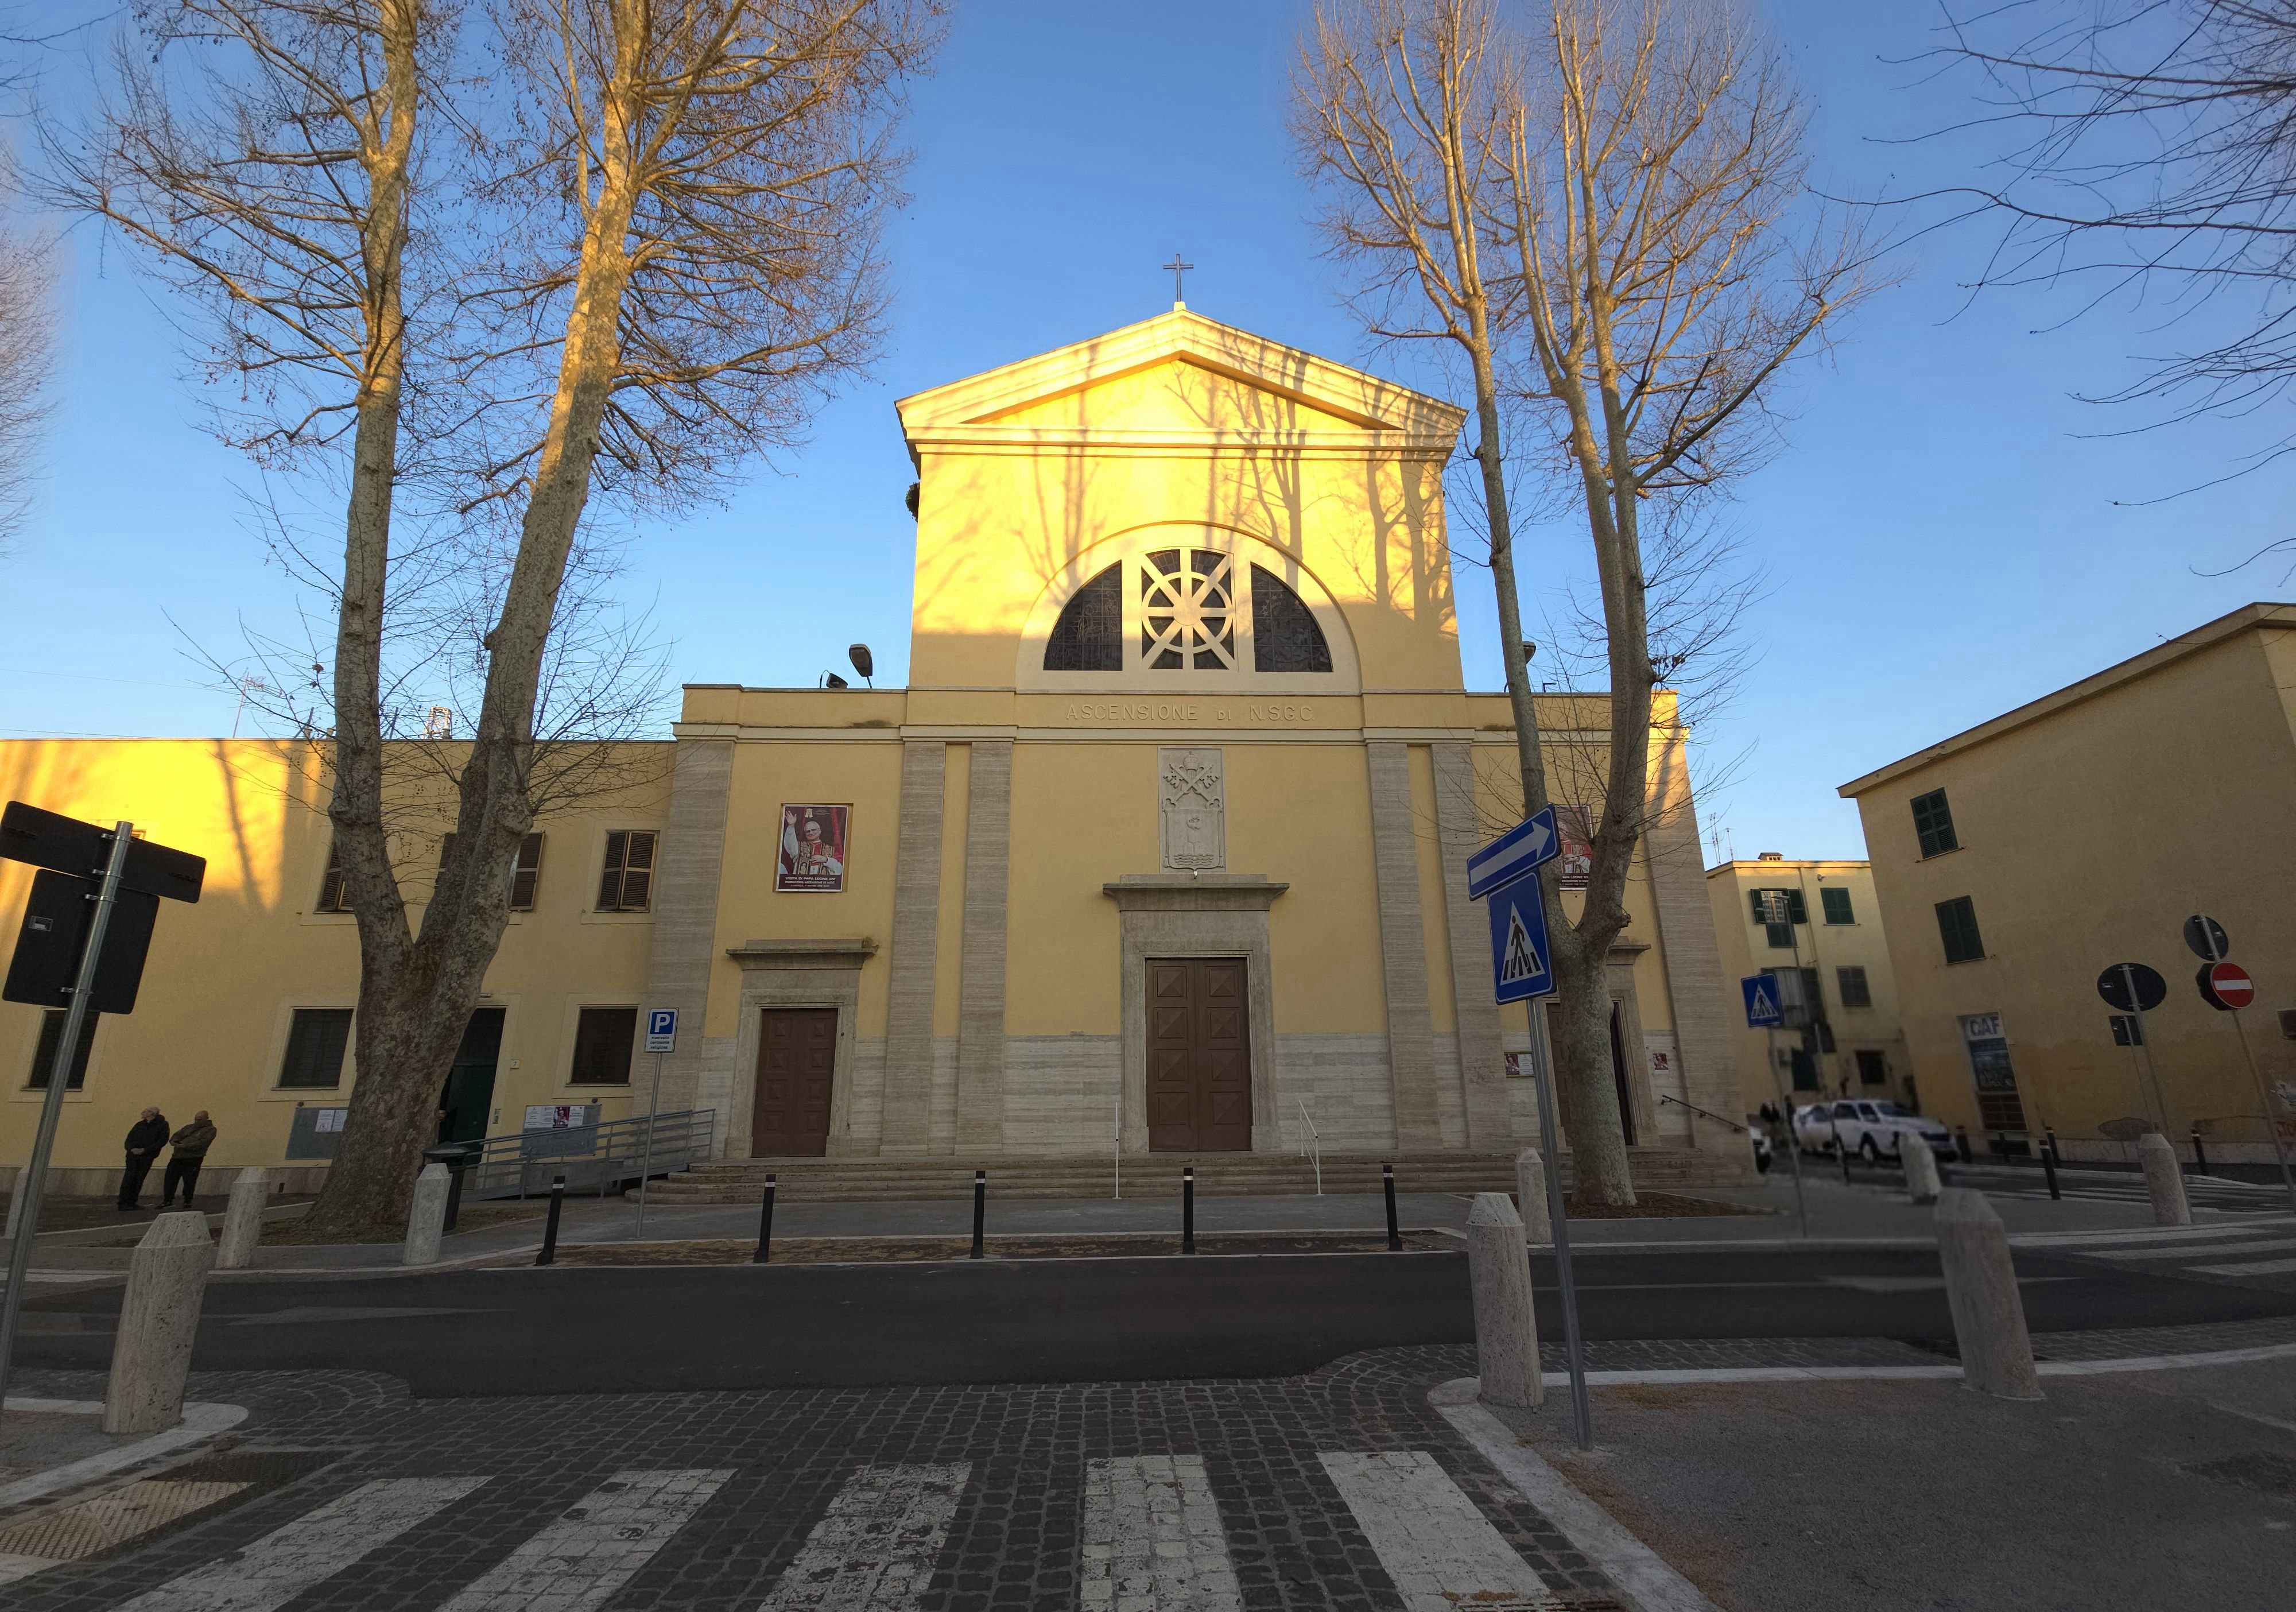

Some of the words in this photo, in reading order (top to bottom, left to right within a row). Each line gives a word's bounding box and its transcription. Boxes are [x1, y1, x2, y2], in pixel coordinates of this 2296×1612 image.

[1066, 704, 1197, 720] ASCENSIONE
[654, 1014, 670, 1033] P
[1969, 1016, 2000, 1036] CAF
